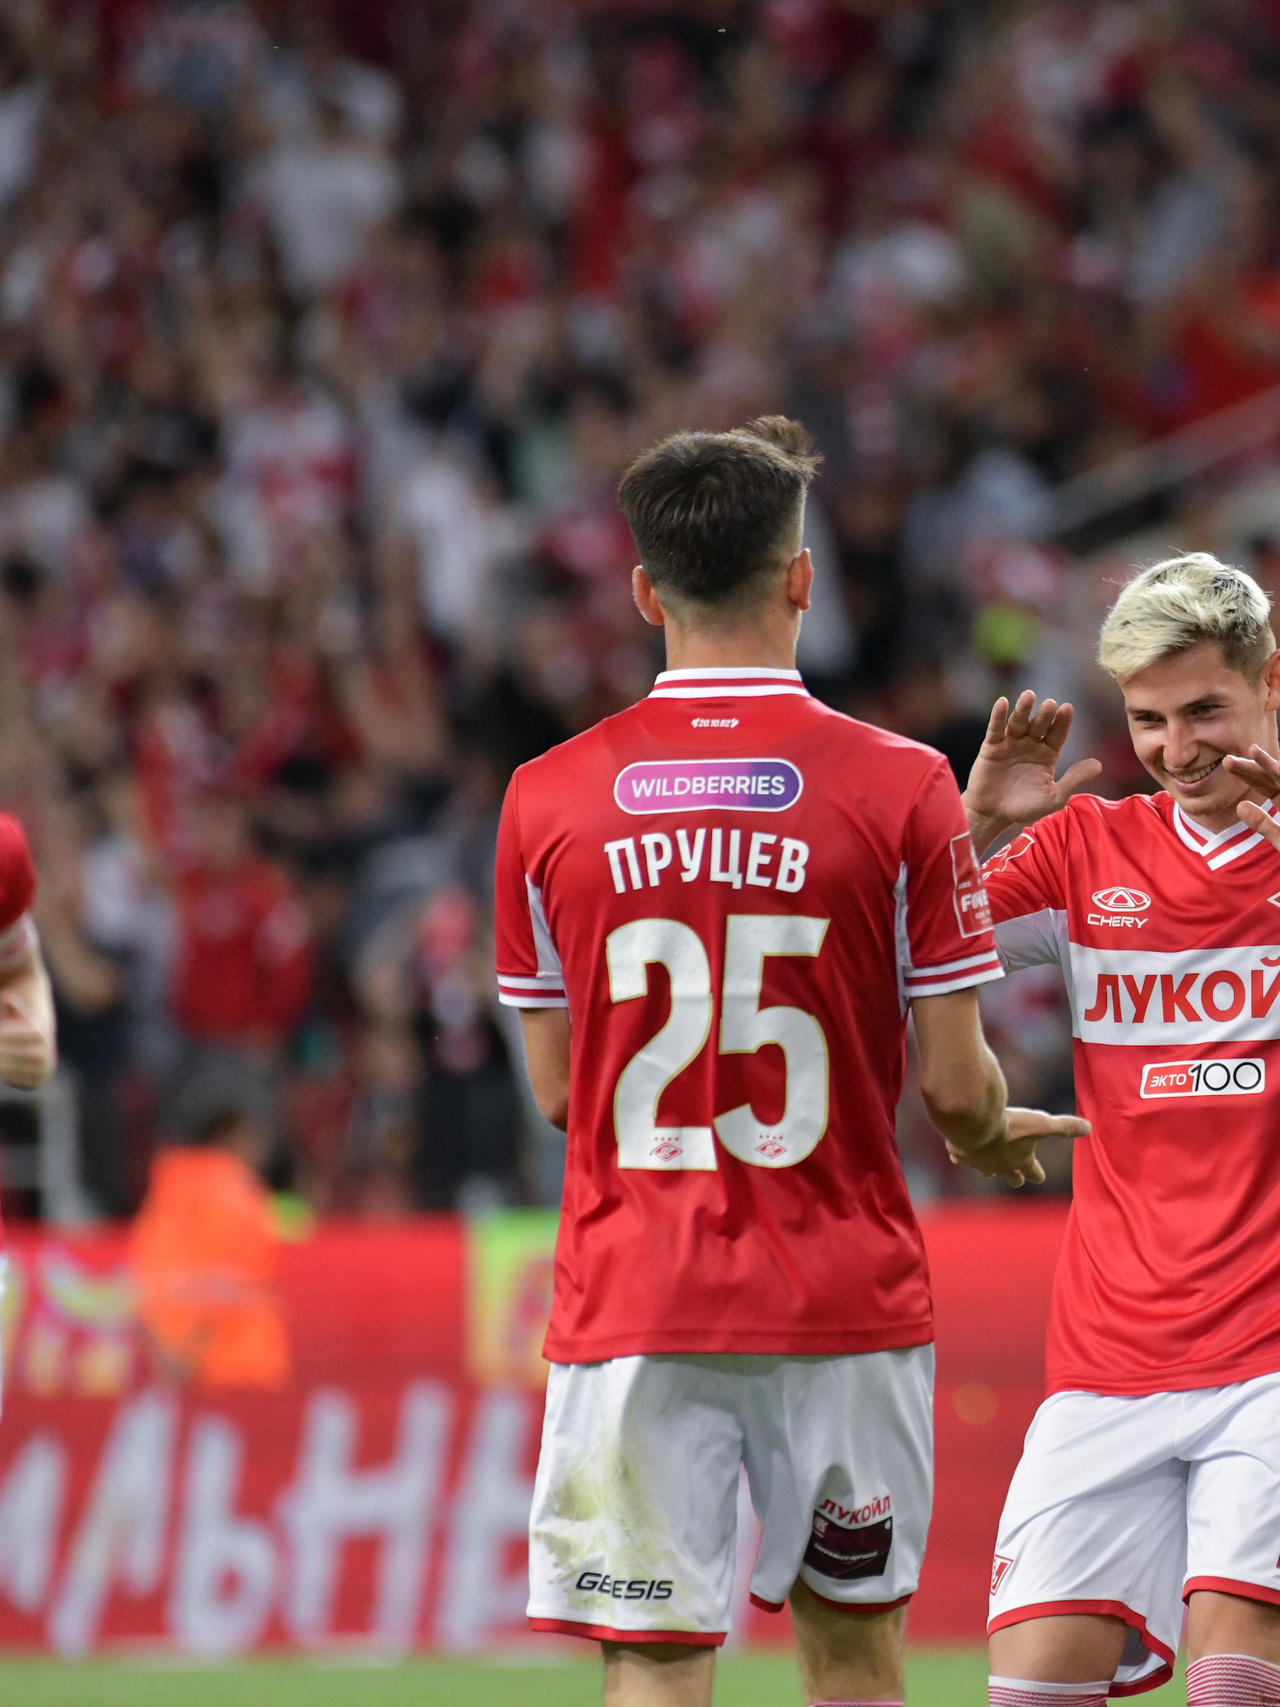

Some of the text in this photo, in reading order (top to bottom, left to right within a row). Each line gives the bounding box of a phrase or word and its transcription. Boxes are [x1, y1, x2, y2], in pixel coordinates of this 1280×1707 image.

[631, 774, 785, 798] WILDBERRIES
[604, 828, 810, 894] ПРУЦЕВ
[1087, 913, 1149, 930] CHERY
[606, 915, 831, 1172] 25
[819, 1495, 892, 1525] ЛУКОЙЛ
